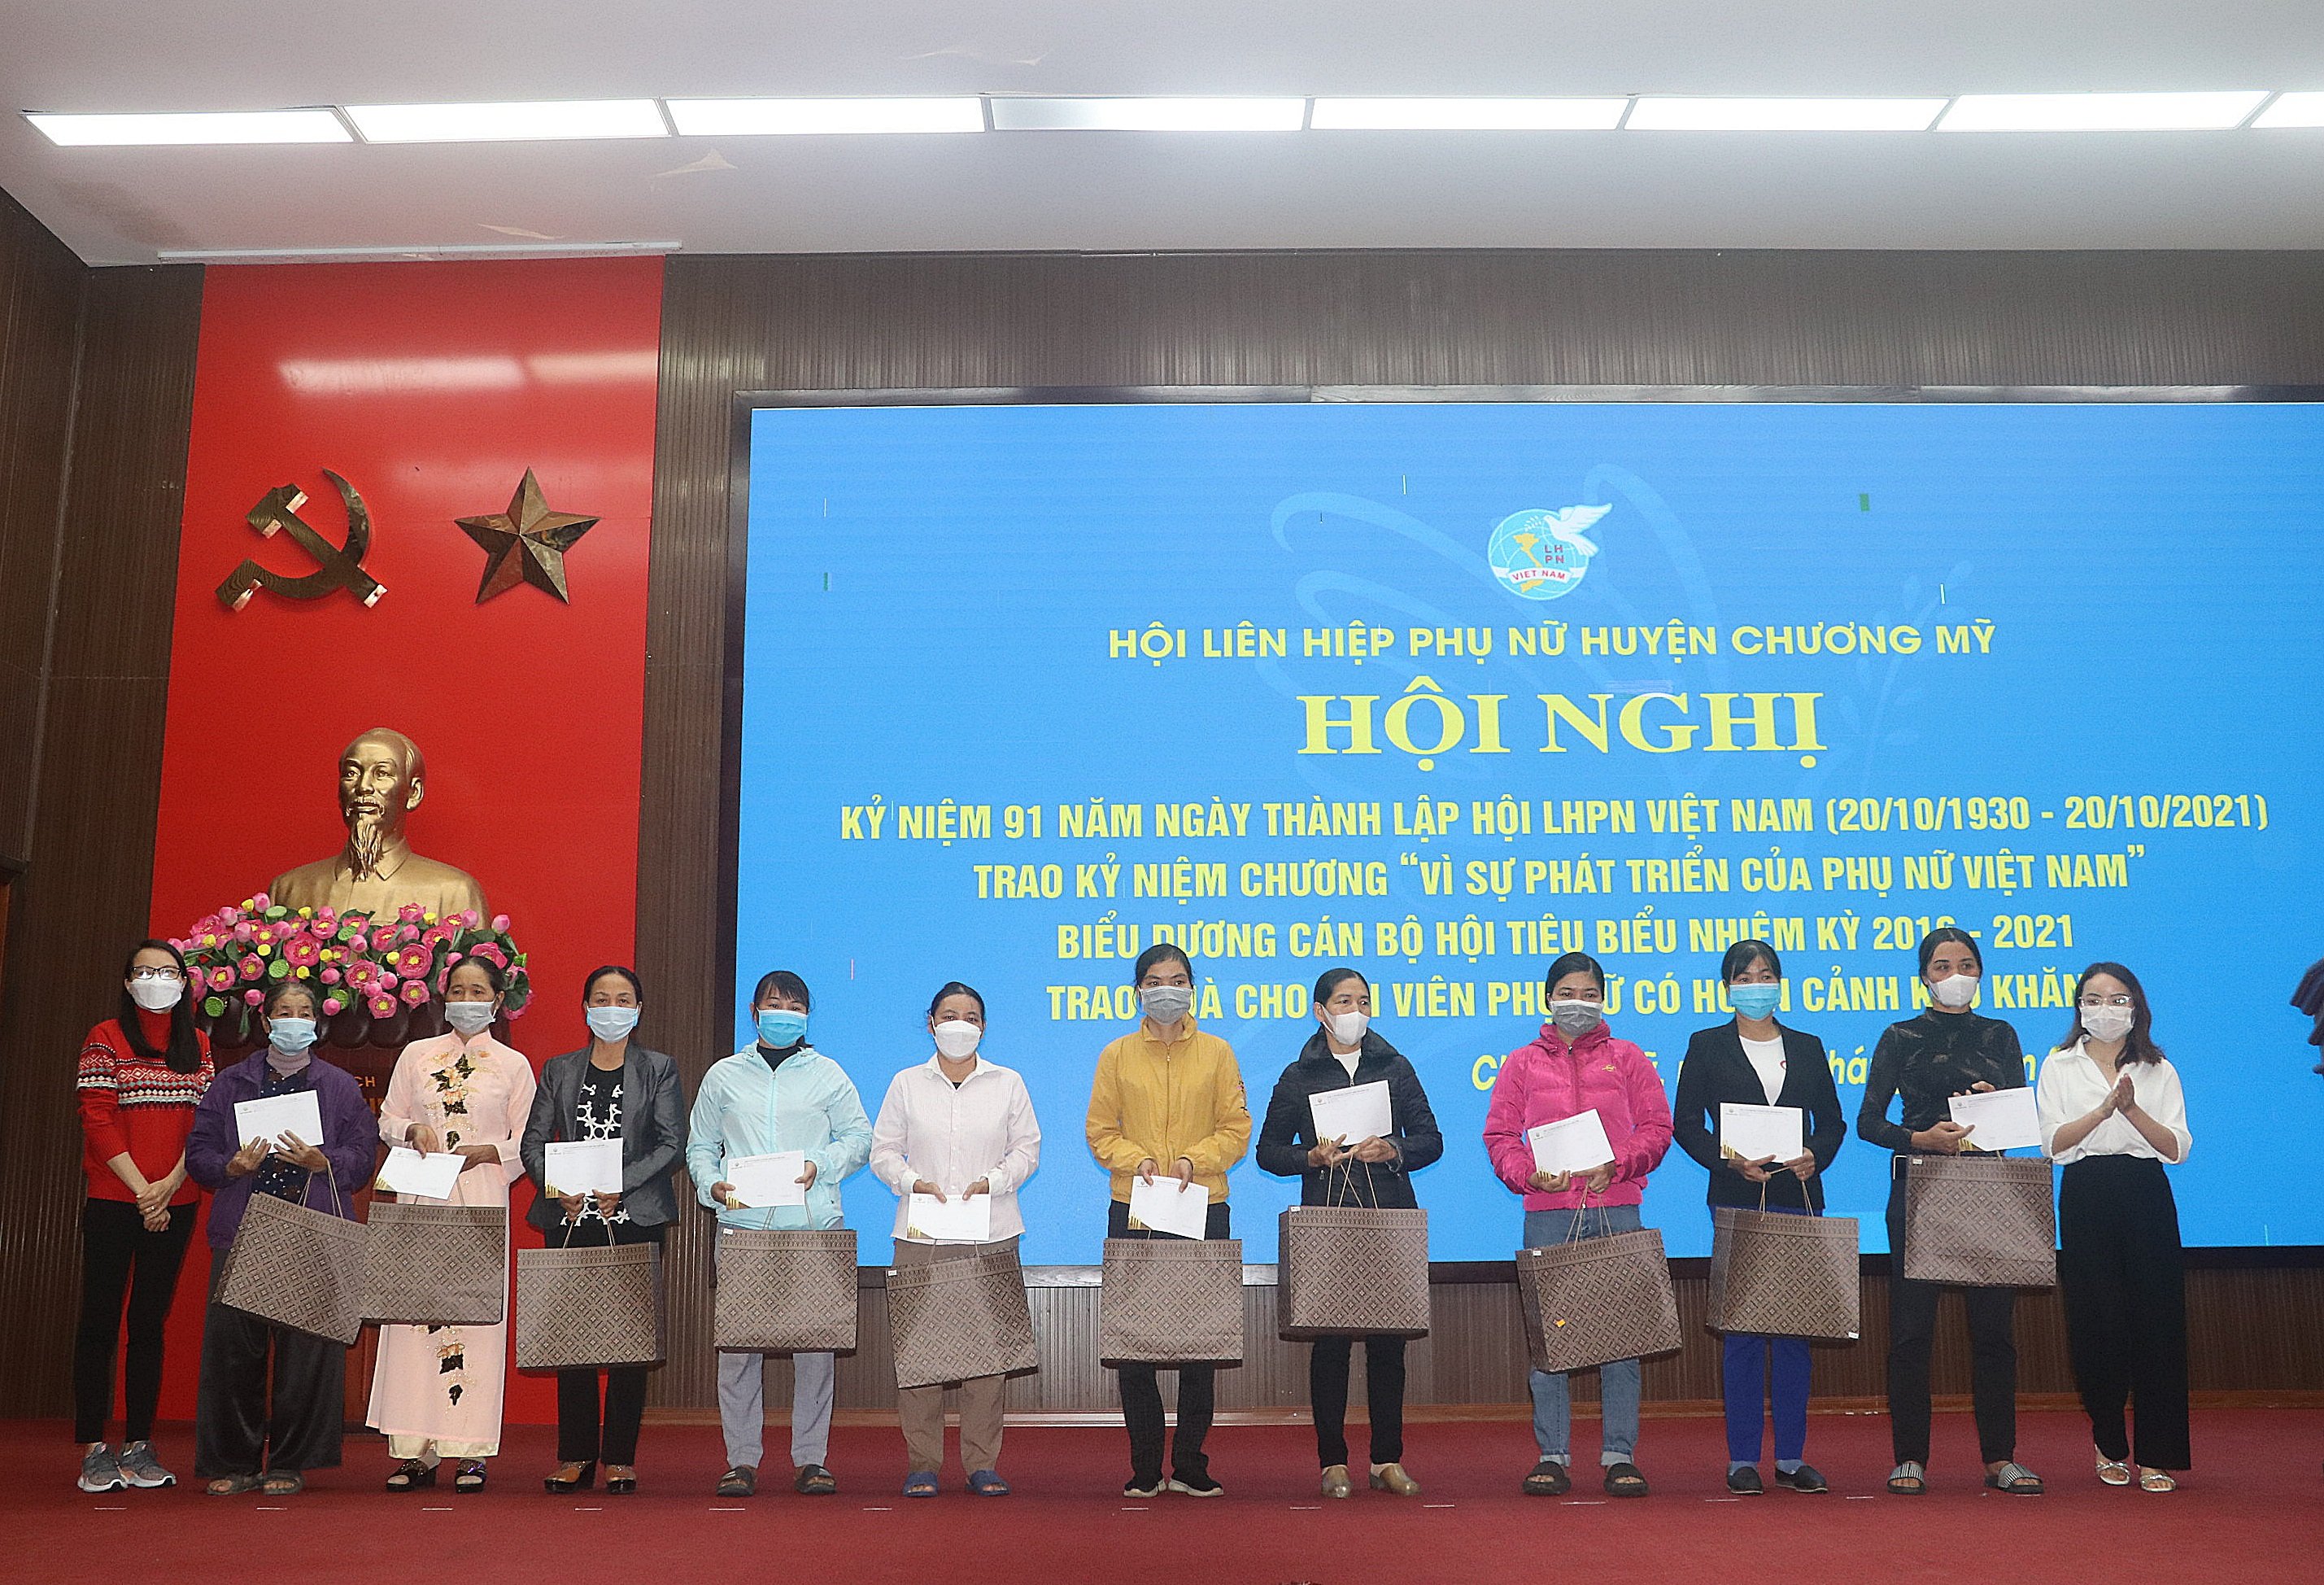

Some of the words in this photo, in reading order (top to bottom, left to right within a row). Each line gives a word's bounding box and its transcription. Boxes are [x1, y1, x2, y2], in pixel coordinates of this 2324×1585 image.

[1542, 570, 1565, 579] NAM
[1110, 621, 1186, 666] HỘI
[1203, 620, 1287, 657] LIÊN
[1303, 619, 1395, 666] HIỆP
[1410, 627, 1493, 665] PHỤ
[1508, 619, 1568, 656] NỮ
[1581, 618, 1717, 664] HUYỆN
[1732, 622, 1922, 655] CHƯƠNG
[1936, 618, 1995, 653] MỸ
[1297, 675, 1511, 771] HỘI
[1537, 692, 1827, 770] NGHỊ
[841, 793, 887, 840] KỶ
[898, 797, 991, 847] NIỆM
[1004, 805, 1041, 839] 91
[1059, 797, 1142, 838] NĂM
[1155, 796, 1251, 837] NGÀY
[1262, 795, 1381, 836] THÀNH
[1393, 794, 1459, 843] LẬP
[1472, 793, 1531, 842] HỘI
[1543, 800, 1636, 834] LHPN
[1646, 792, 1720, 841] VIỆT
[1731, 798, 1813, 832] NAM
[1826, 797, 2030, 835] (20/10/1930
[2065, 794, 2268, 830] 20/10/2021)
[973, 863, 1063, 899] TRAO
[1076, 852, 1121, 898] KỶ
[1133, 856, 1227, 905] NIỆM
[1240, 858, 1388, 897] CHƯƠNG
[1466, 857, 1516, 902] SỰ
[1524, 852, 1615, 894] PHÁT
[1625, 842, 1729, 893] TRIỂN
[1741, 846, 1812, 893] CỦA
[1822, 856, 1893, 898] PHỤ
[1903, 849, 1956, 890] NỮ
[1962, 848, 2035, 897] VIỆT
[1057, 910, 1140, 959] BIỂU
[1153, 919, 1276, 958] DƯƠNG
[1289, 915, 1363, 958] CÁN
[1376, 914, 1424, 964] BỘ
[1436, 914, 1495, 963] HỘI
[1506, 913, 1585, 955] TIÊU
[1596, 905, 1677, 954] BIỂU
[1816, 909, 1860, 951] KỲ
[1993, 914, 2073, 949] 2021
[1046, 985, 1137, 1020] TRAO
[1236, 984, 1308, 1020] CHO
[1392, 975, 1476, 1017] VIÊN
[1633, 972, 1681, 1015] CÓ
[1803, 965, 1899, 1012] CẢNH
